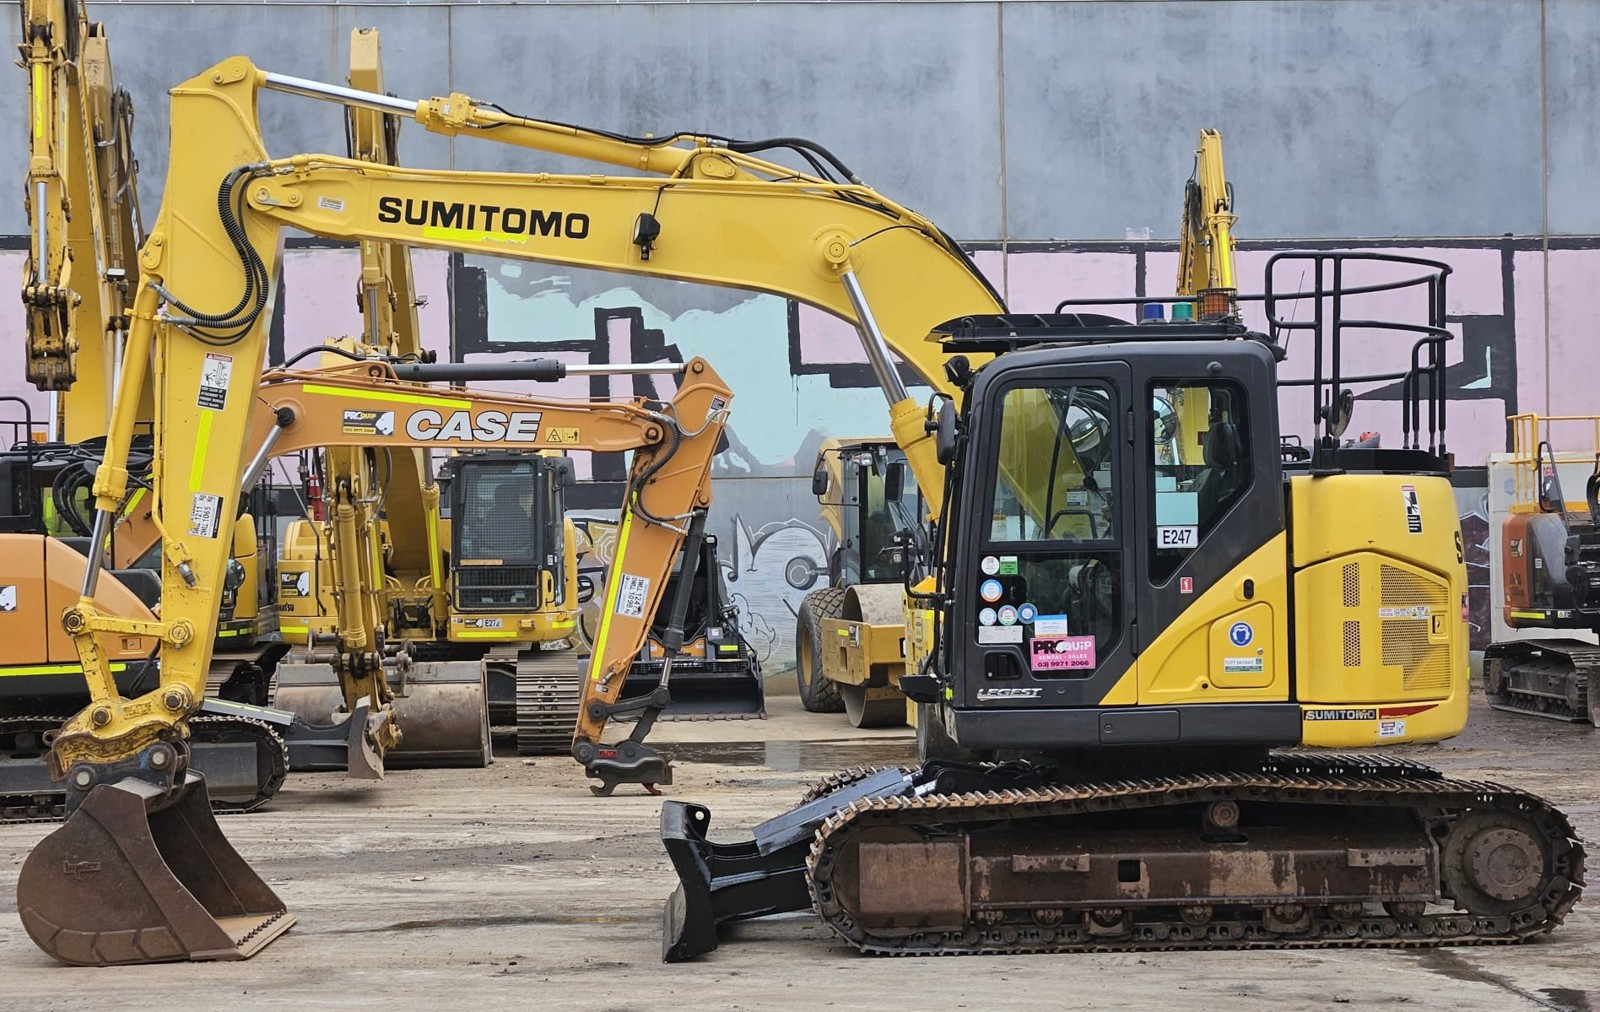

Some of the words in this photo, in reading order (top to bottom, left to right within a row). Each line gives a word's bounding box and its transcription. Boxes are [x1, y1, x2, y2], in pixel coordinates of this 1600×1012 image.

[378, 196, 590, 239] SUMITOMO
[405, 409, 543, 442] CASE
[202, 506, 212, 522] 1065
[1163, 529, 1192, 545] E247
[977, 688, 1042, 697] LEGEST
[1306, 710, 1376, 720] SUMITOMO
